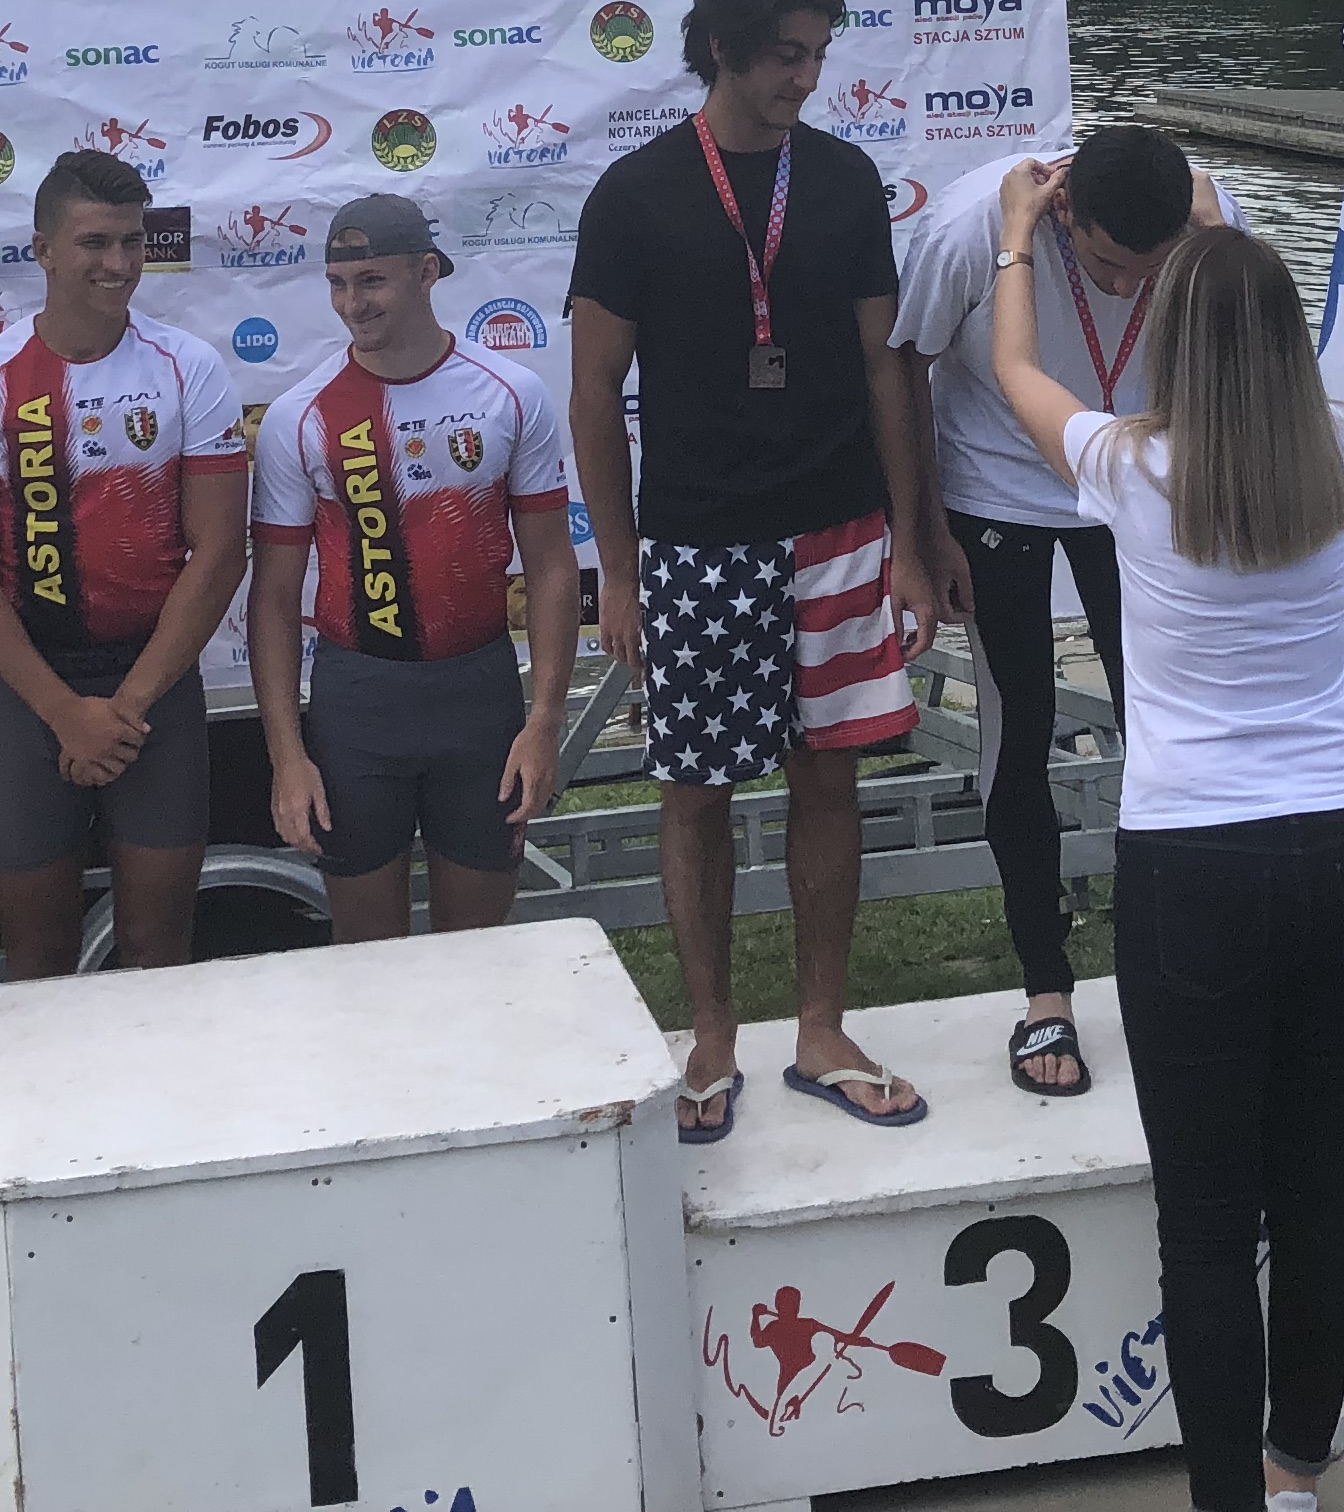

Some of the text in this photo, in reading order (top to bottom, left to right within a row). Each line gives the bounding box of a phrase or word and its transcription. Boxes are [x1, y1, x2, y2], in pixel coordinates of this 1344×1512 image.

[600, 3, 640, 21] LZS
[843, 8, 893, 29] nac
[453, 23, 542, 48] sonac
[913, 27, 1025, 45] STACJA SZTUM
[65, 43, 160, 68] sonac
[204, 59, 236, 70] KOGUT
[272, 58, 328, 69] KOMUNALNE
[925, 82, 1034, 121] moya
[382, 112, 423, 131] LZS
[608, 107, 689, 123] KANCELARIA
[203, 113, 300, 142] Fobos
[925, 122, 1036, 141] STACJA SZTUM
[143, 232, 185, 245] LIOR
[461, 238, 493, 248] KOGUT
[144, 245, 178, 260] ANK
[235, 333, 276, 349] LIDO
[17, 393, 67, 606] ASTORIA
[340, 417, 403, 638] ASTORIA
[1025, 1023, 1065, 1048] NIKE
[943, 1214, 1078, 1438] 3
[253, 1269, 359, 1507] 1
